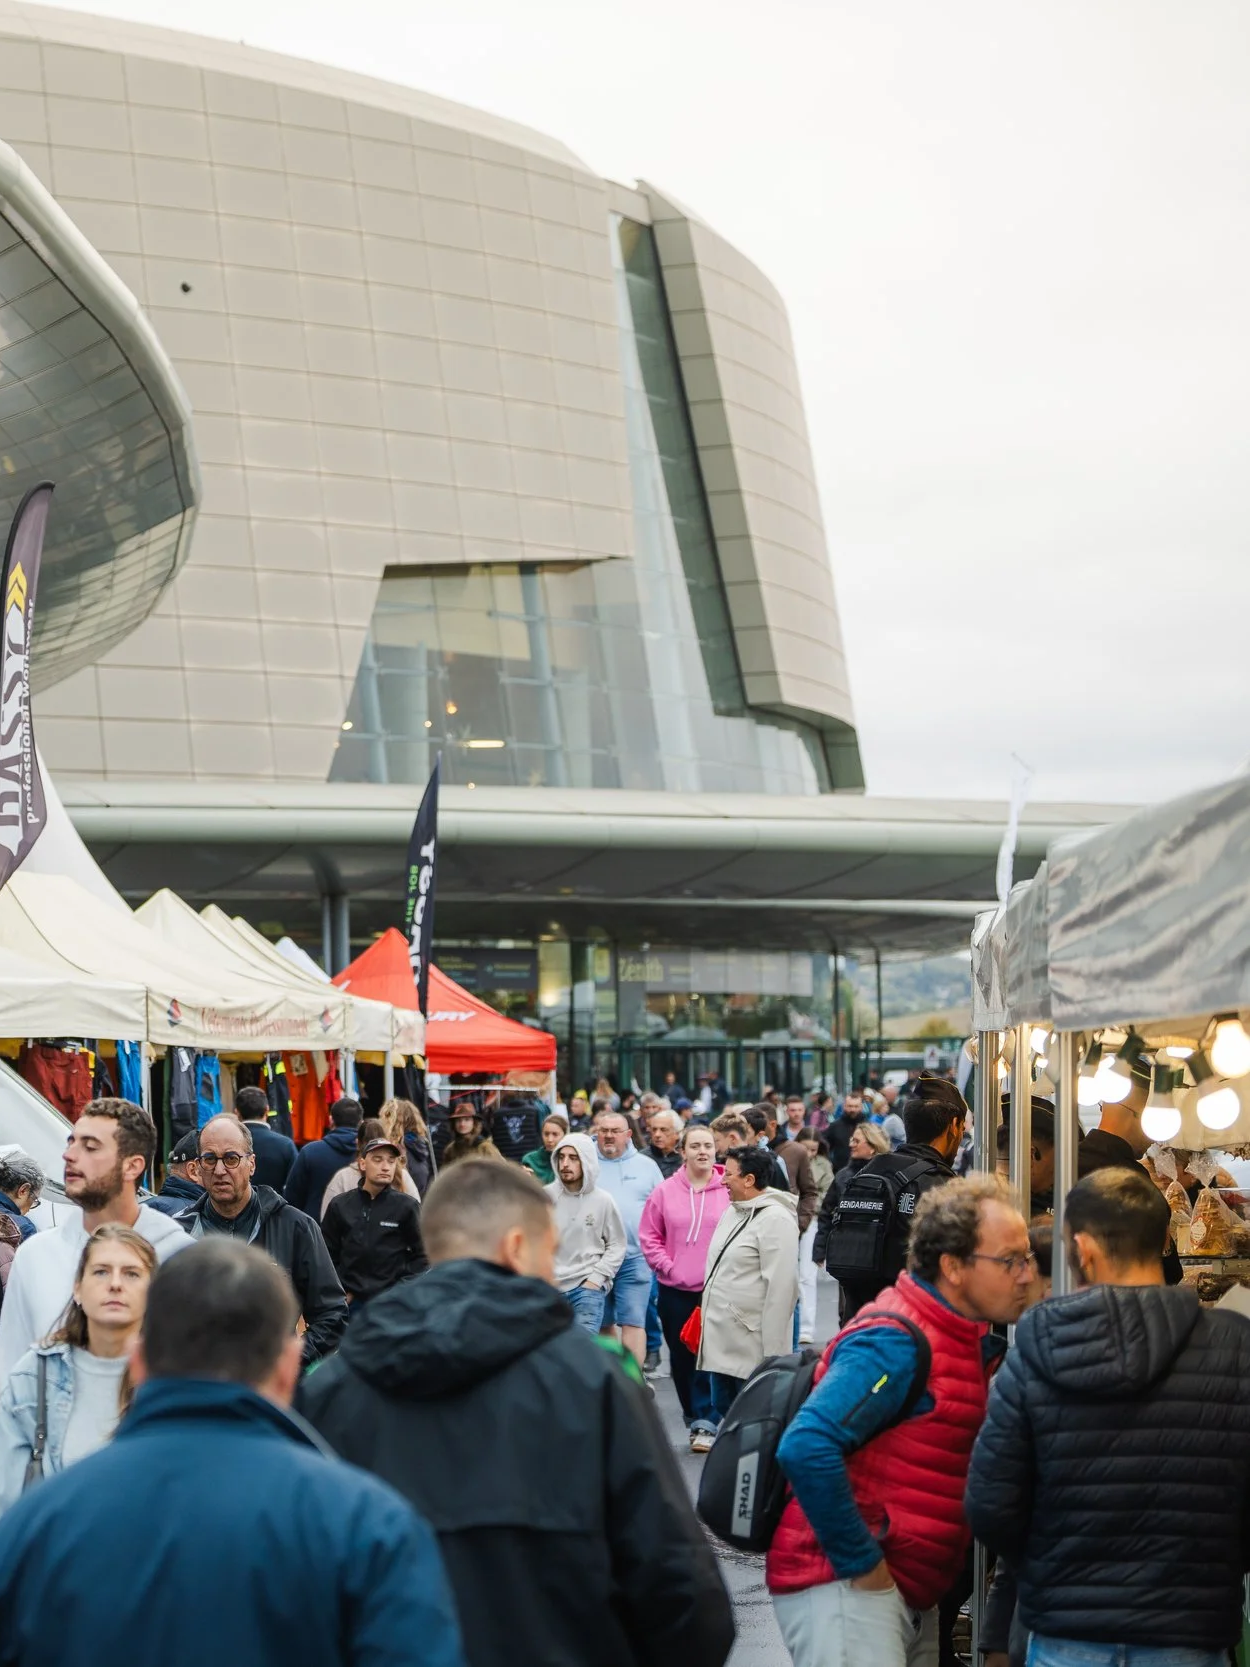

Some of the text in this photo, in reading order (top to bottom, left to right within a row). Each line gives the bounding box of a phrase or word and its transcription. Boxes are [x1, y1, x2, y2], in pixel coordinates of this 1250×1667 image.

[22, 706, 40, 824] professional
[839, 1200, 883, 1211] GENDARMERIE
[738, 1472, 752, 1519] SHAD
